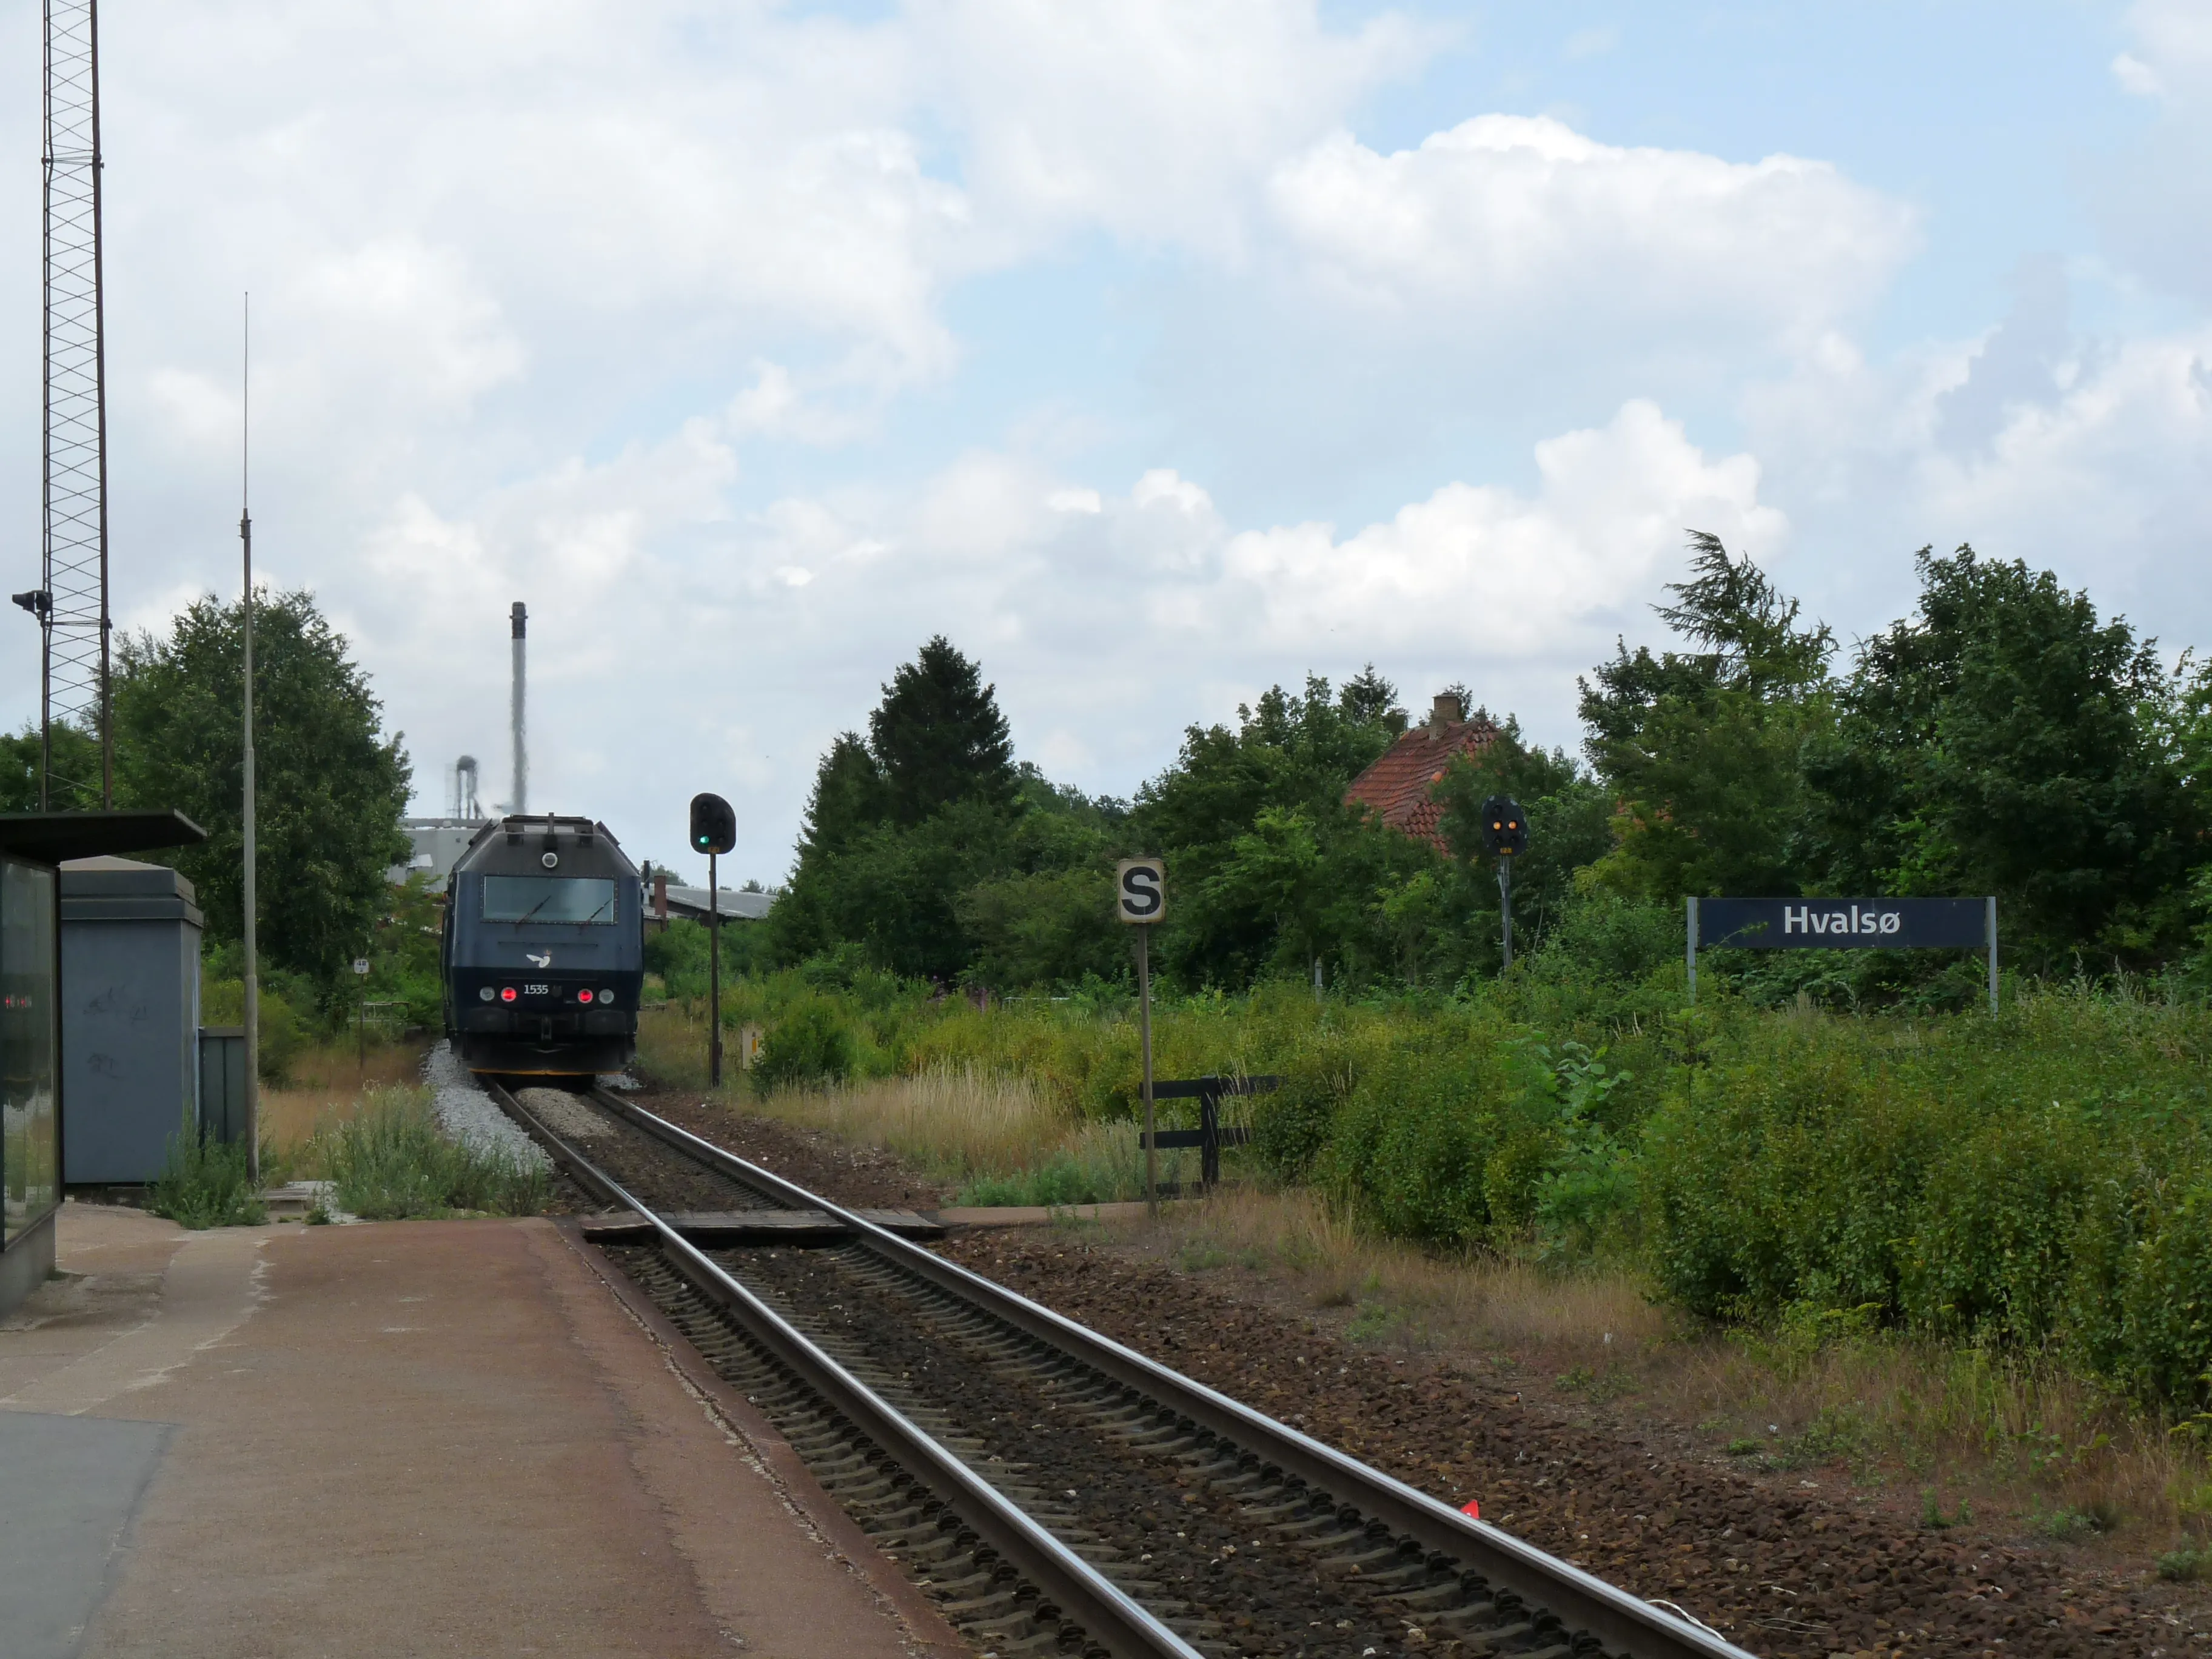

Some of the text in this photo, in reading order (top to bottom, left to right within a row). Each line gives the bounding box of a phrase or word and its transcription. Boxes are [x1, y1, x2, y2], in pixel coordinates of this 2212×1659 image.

[1121, 866, 1161, 916] S
[1784, 905, 1901, 934] Hvalsø
[523, 984, 549, 994] 1535
